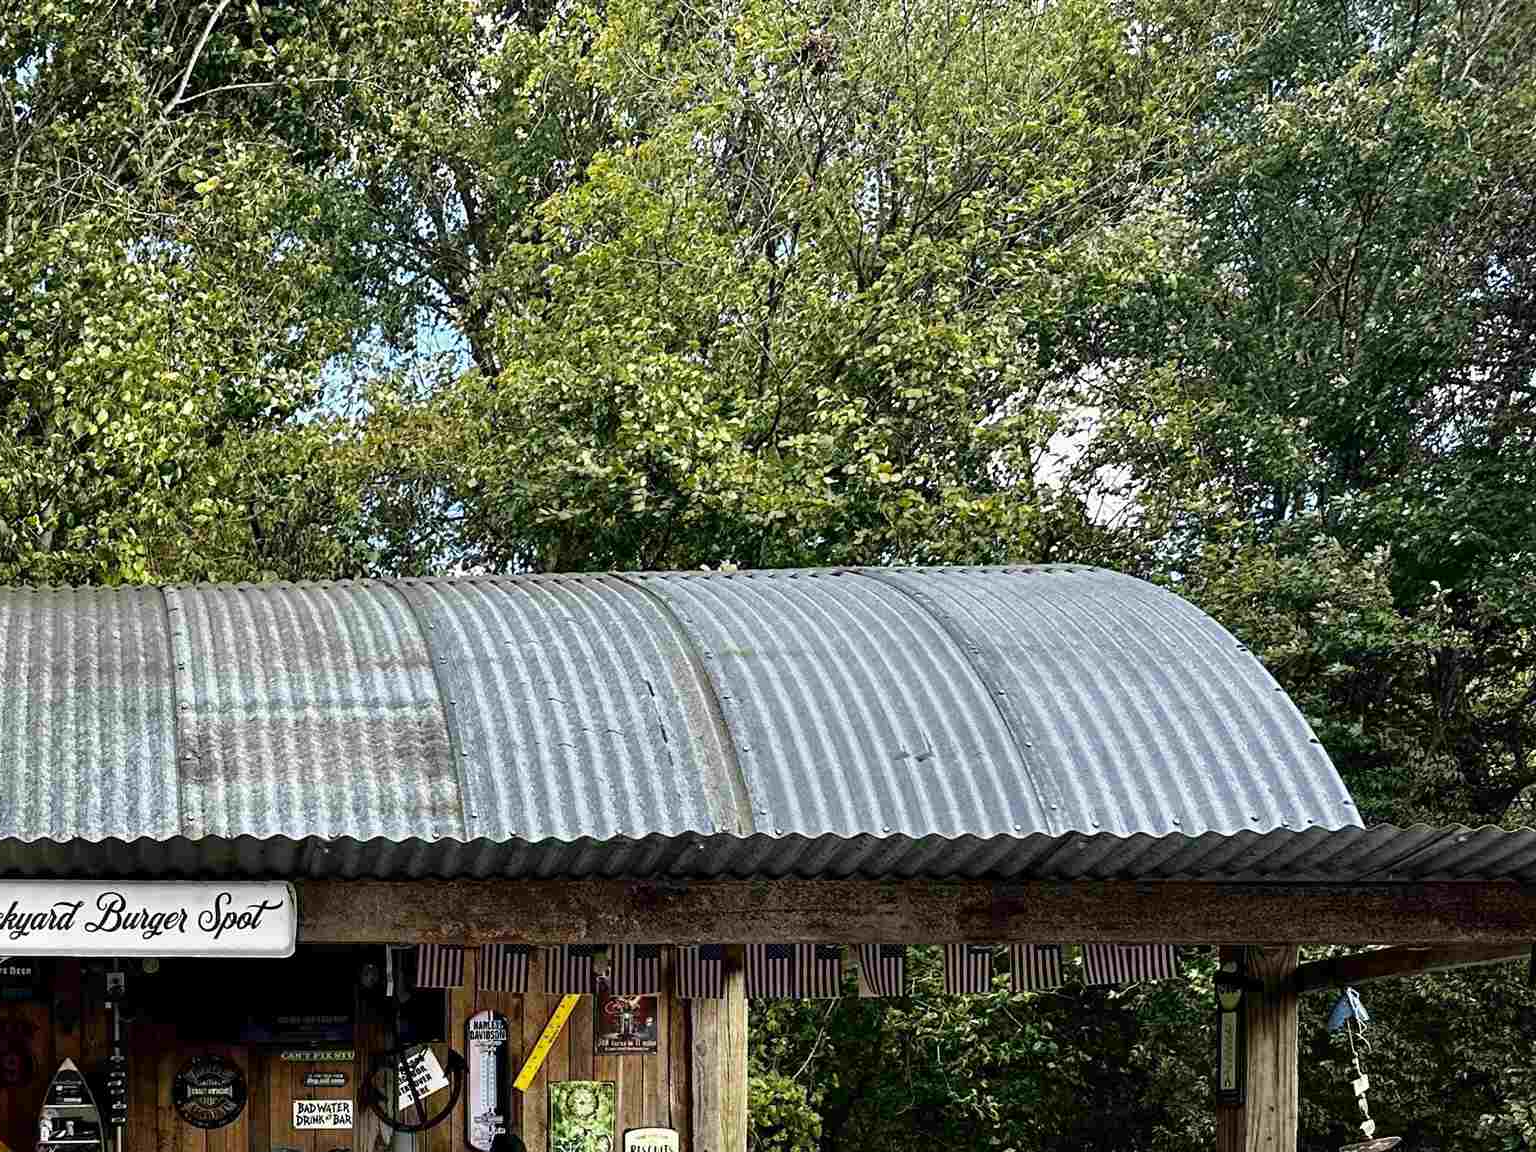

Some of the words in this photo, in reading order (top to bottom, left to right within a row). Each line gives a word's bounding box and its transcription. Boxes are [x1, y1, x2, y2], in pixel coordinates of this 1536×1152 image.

[85, 891, 189, 941] Burger
[198, 891, 284, 940] Spot
[297, 1102, 317, 1114] BAD
[317, 1102, 350, 1114] WATER
[296, 1114, 325, 1126] DRINK
[333, 1114, 352, 1125] BAR
